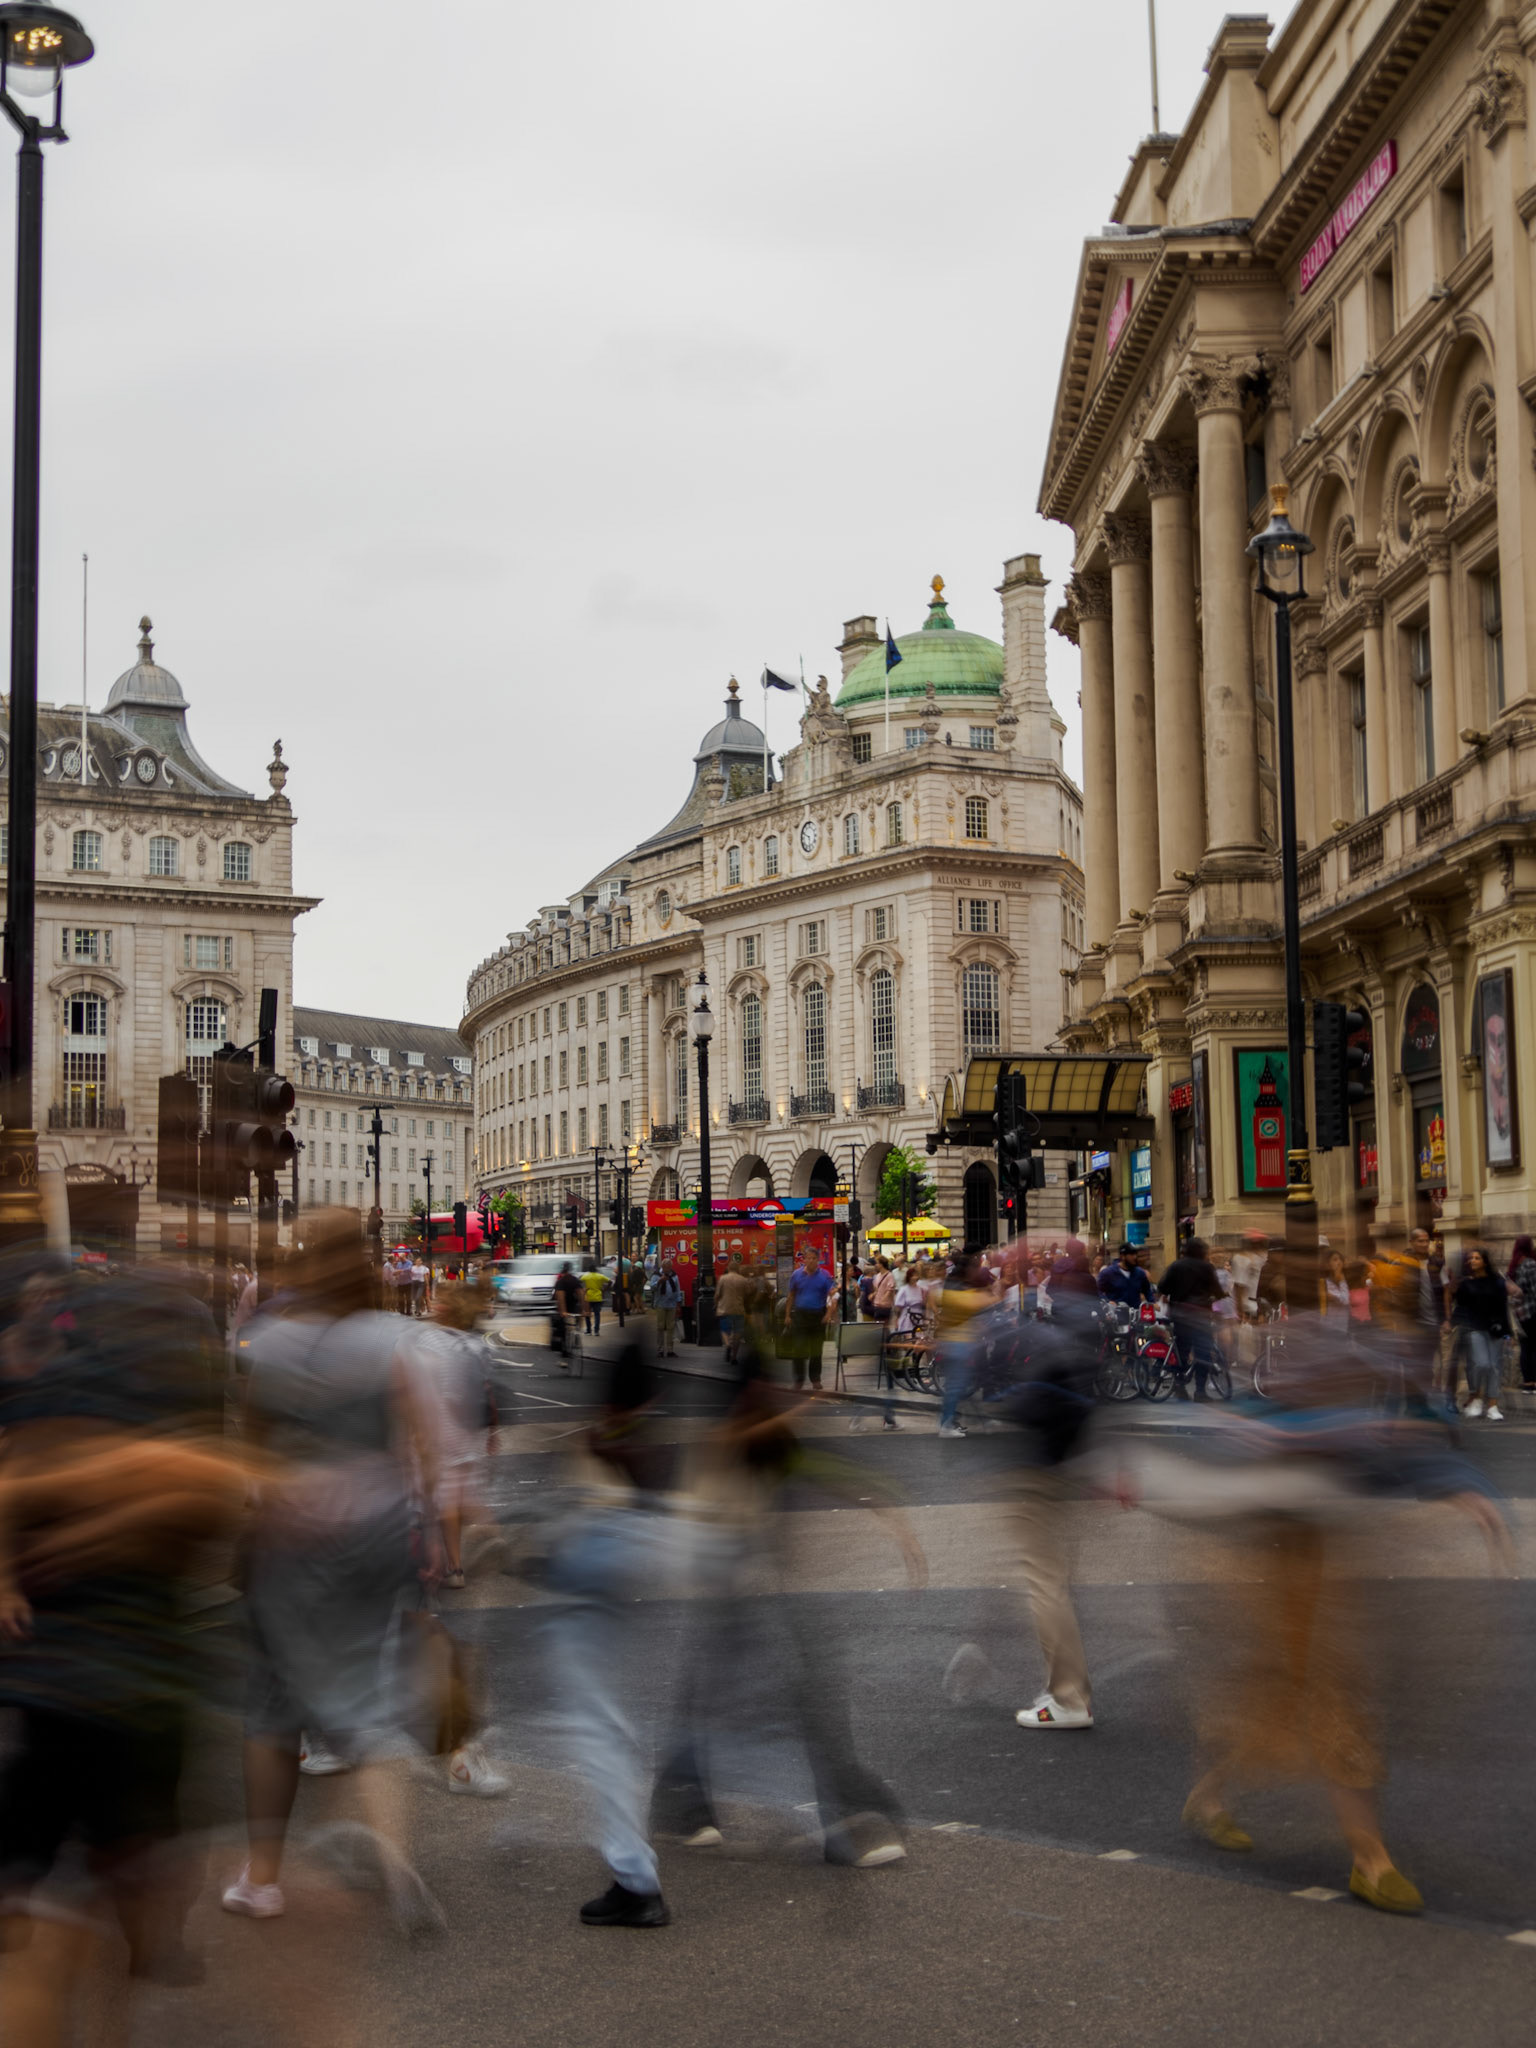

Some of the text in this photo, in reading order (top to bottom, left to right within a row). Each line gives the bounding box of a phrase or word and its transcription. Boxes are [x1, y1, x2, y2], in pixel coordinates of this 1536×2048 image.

[1301, 145, 1389, 289] BODY WORLDS
[937, 875, 1023, 890] ALLIANCE LIFE OFFICE
